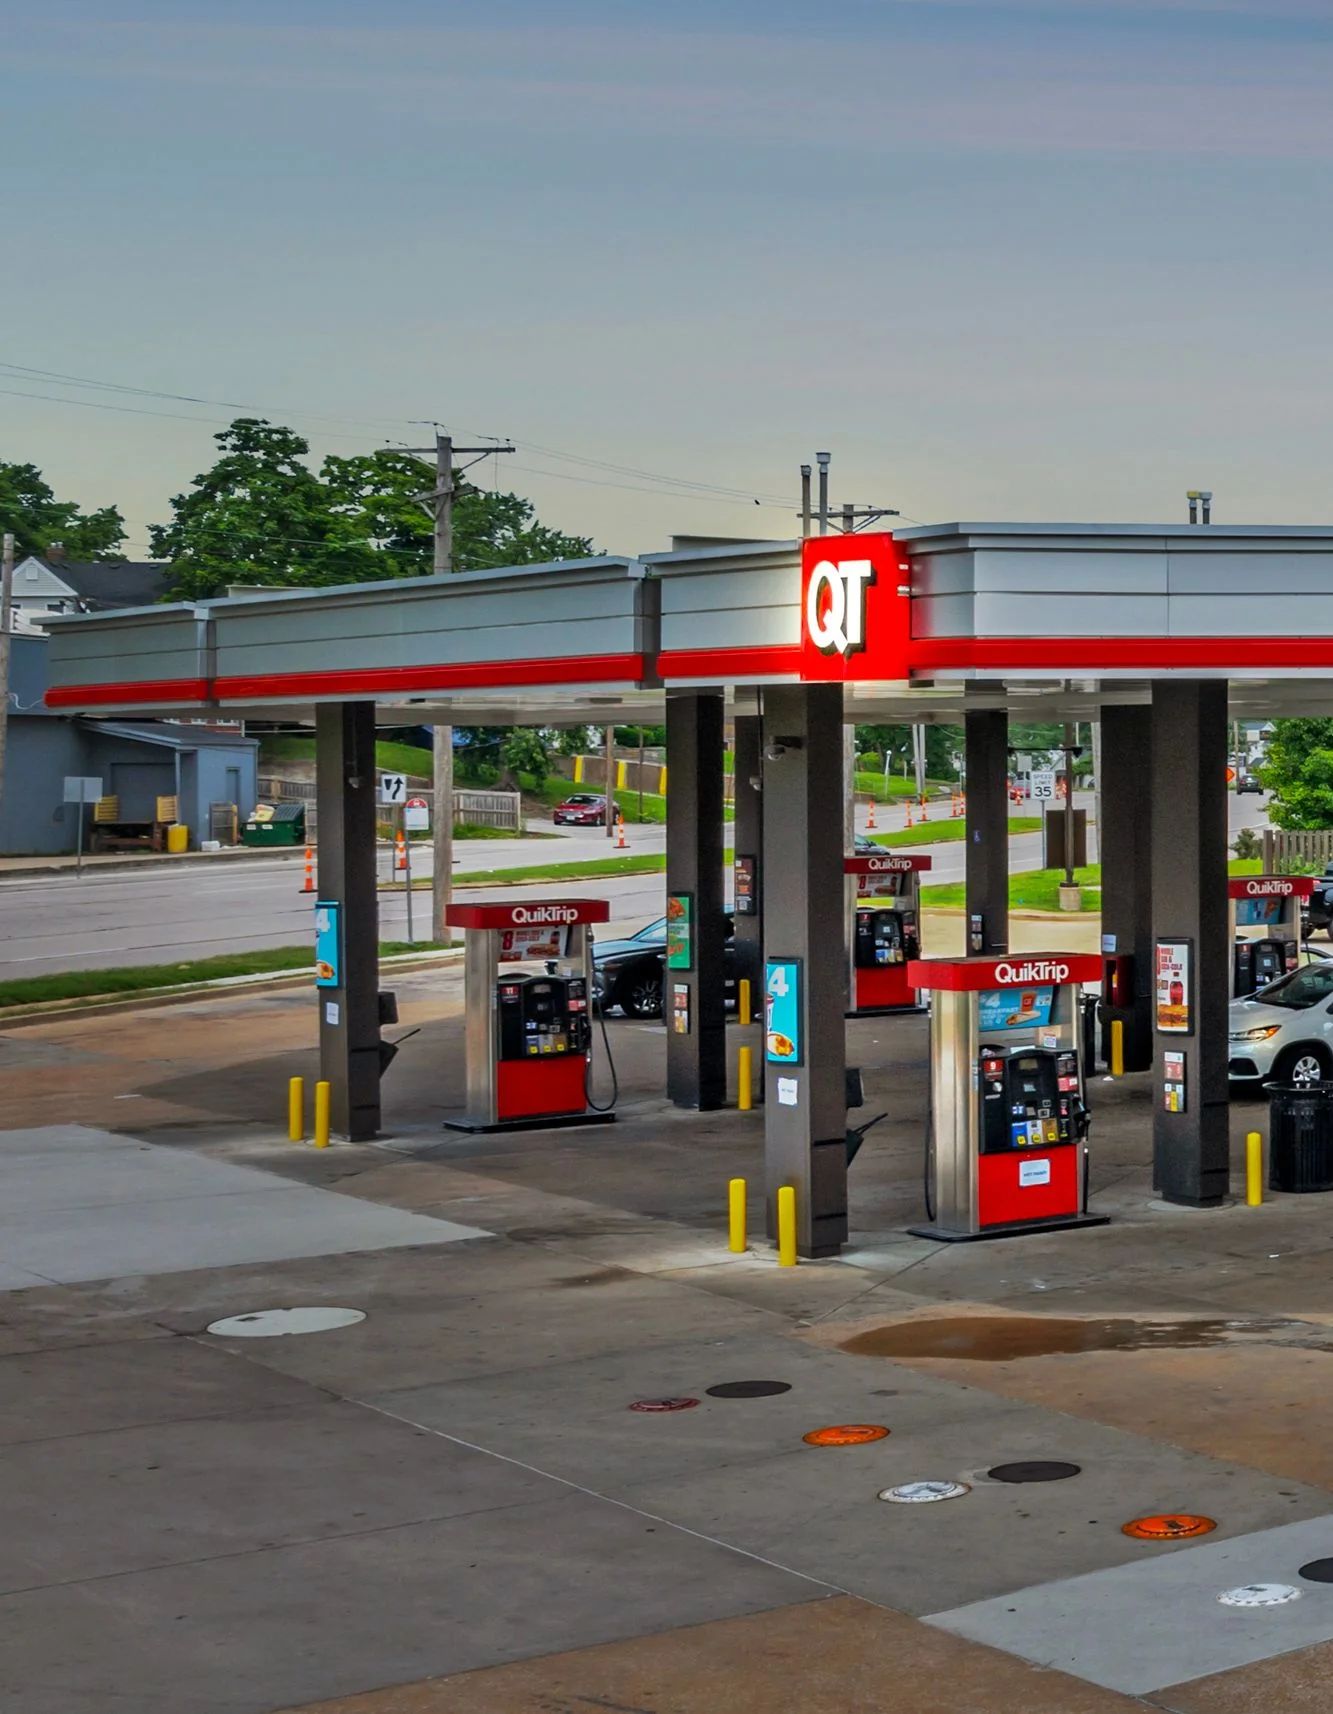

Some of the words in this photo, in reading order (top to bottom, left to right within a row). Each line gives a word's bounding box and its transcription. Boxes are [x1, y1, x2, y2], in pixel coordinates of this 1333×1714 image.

[807, 559, 873, 656] QT
[1034, 786, 1052, 797] 35
[868, 858, 912, 870] QuikTrip
[1246, 881, 1293, 895] QuikTrip
[511, 906, 579, 924] QuikTrip
[994, 961, 1069, 983] QuikTrip
[768, 967, 789, 996] 4
[990, 1061, 996, 1070] 9
